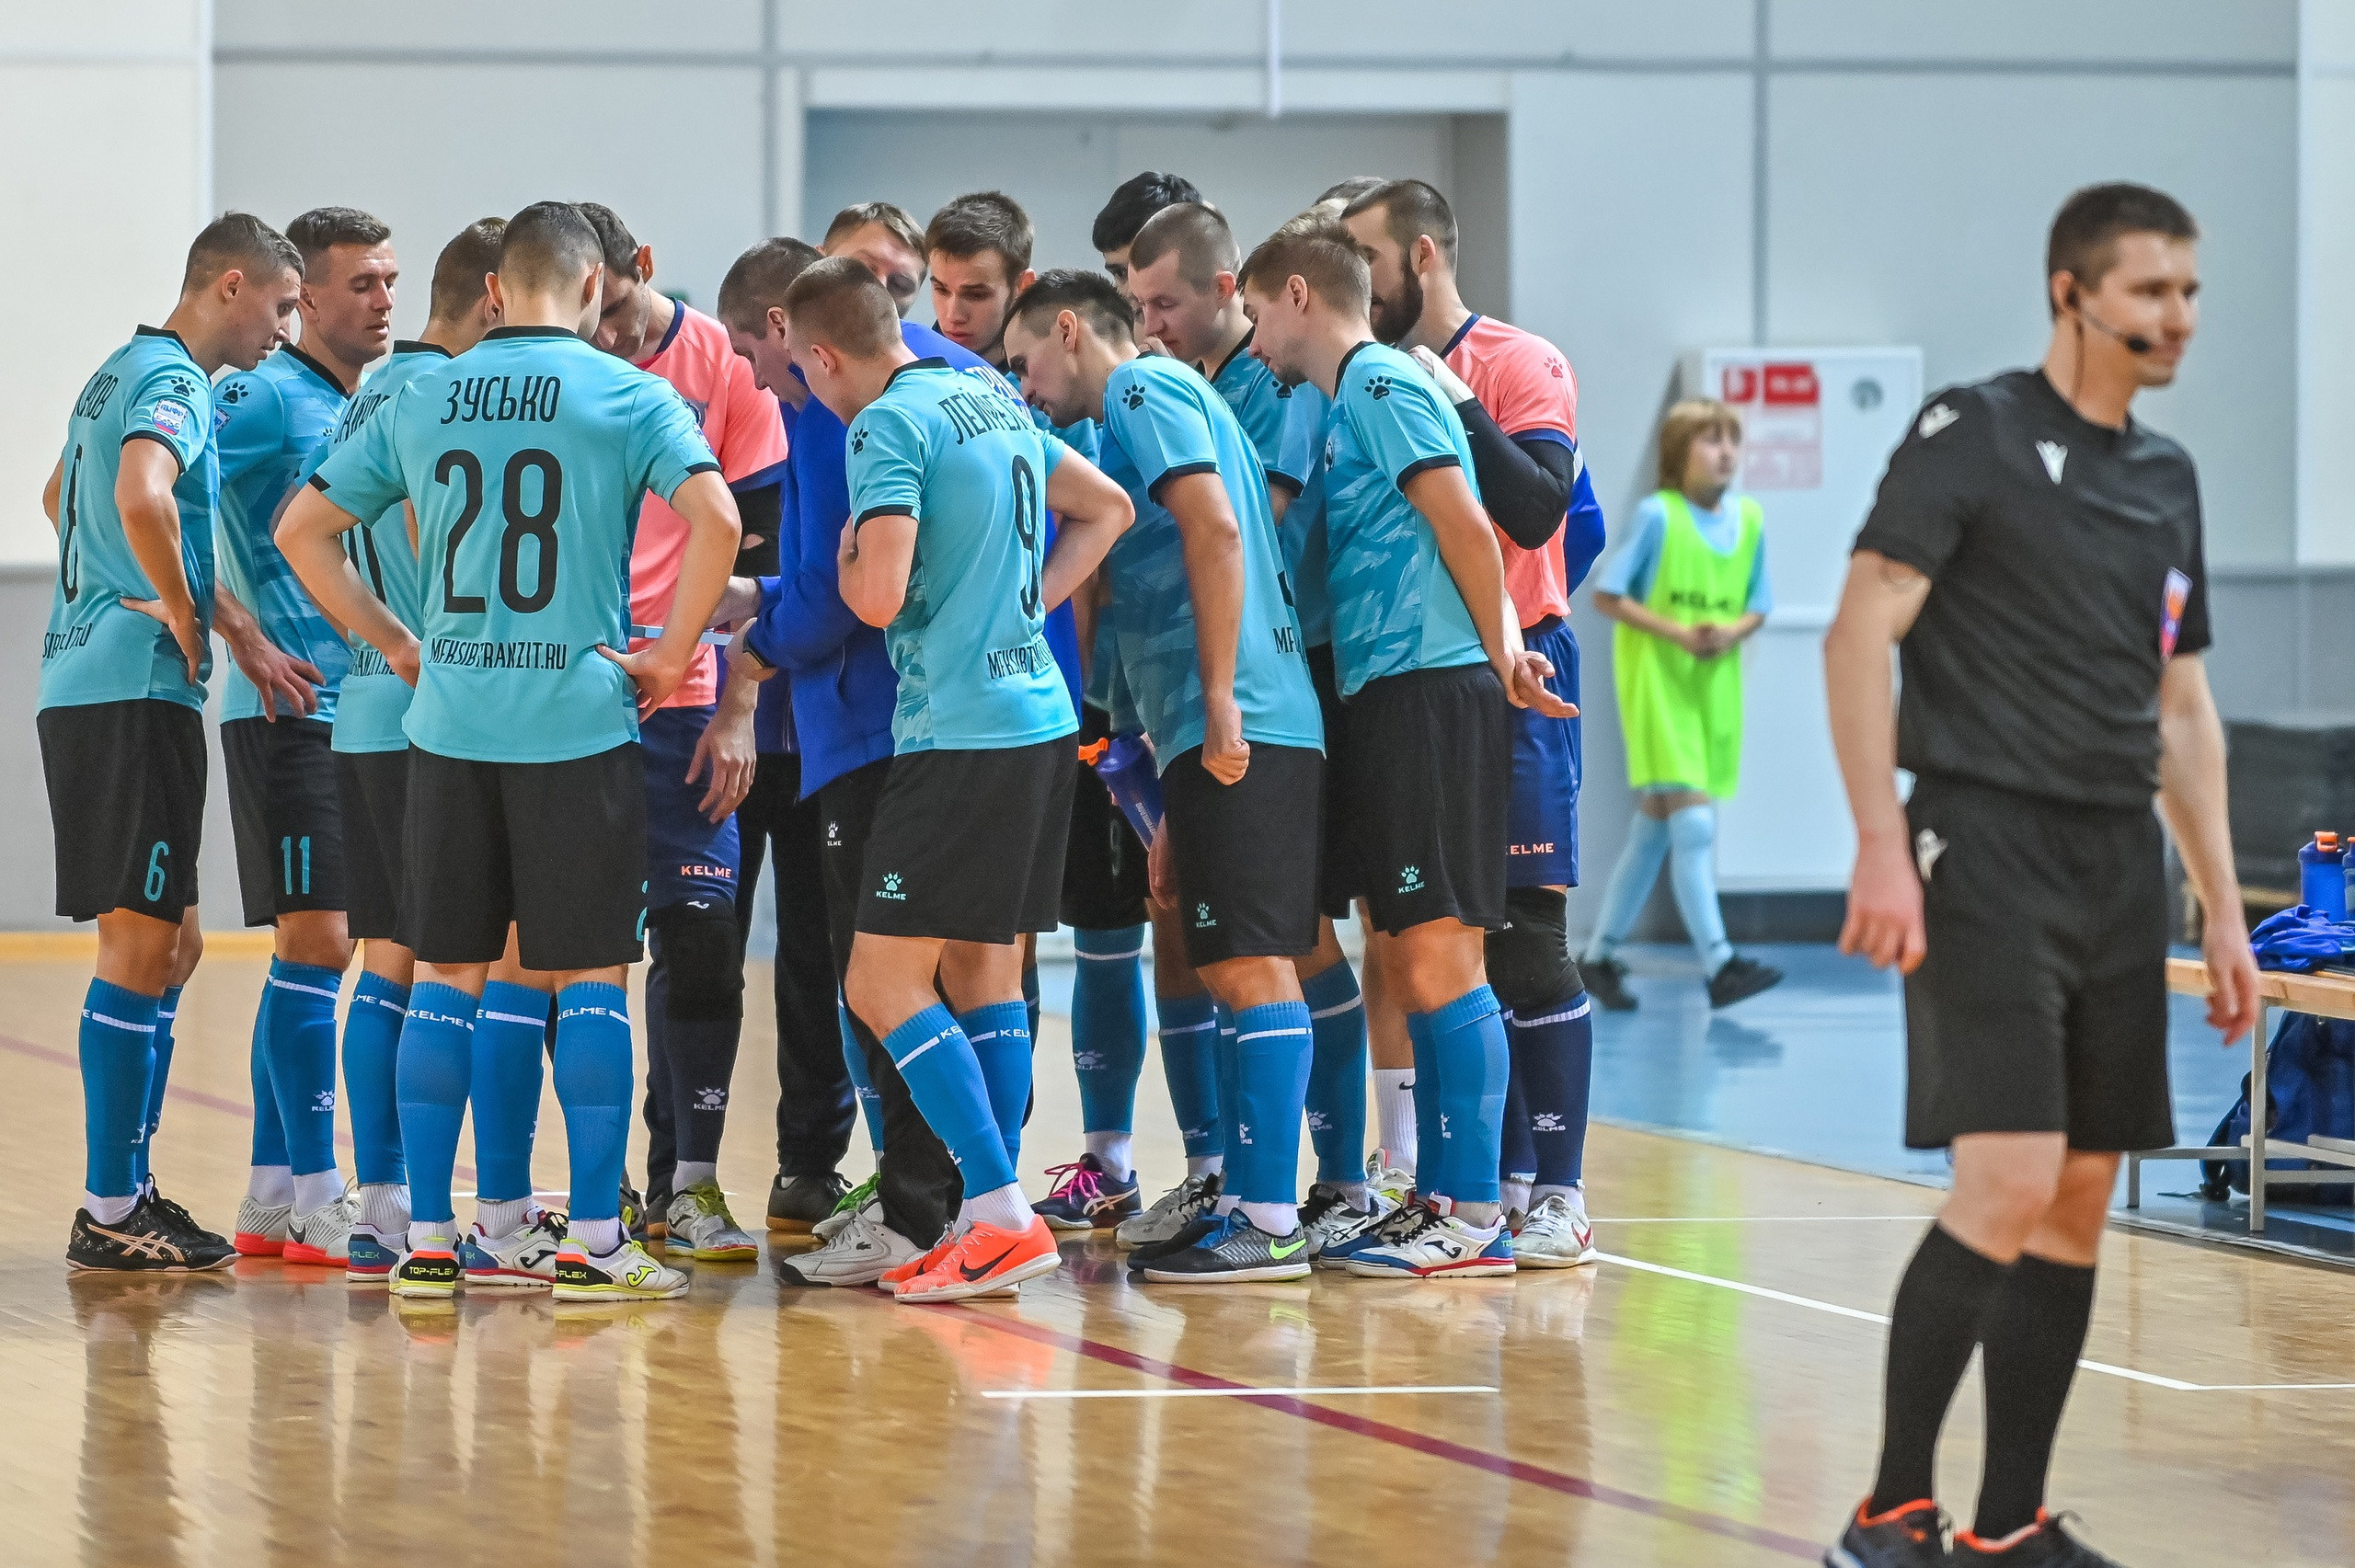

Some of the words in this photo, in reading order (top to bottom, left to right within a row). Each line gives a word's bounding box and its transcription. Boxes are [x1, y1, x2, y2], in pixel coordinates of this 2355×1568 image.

[440, 375, 561, 425] ЗУСЬКО
[434, 448, 563, 614] 28
[1012, 455, 1039, 620] 9
[281, 835, 310, 895] 11
[1507, 842, 1554, 855] ELME
[144, 841, 169, 902] 6
[681, 865, 732, 878] KELME
[1398, 881, 1425, 893] KELME
[876, 890, 906, 900] KELME
[408, 1010, 464, 1027] KELME
